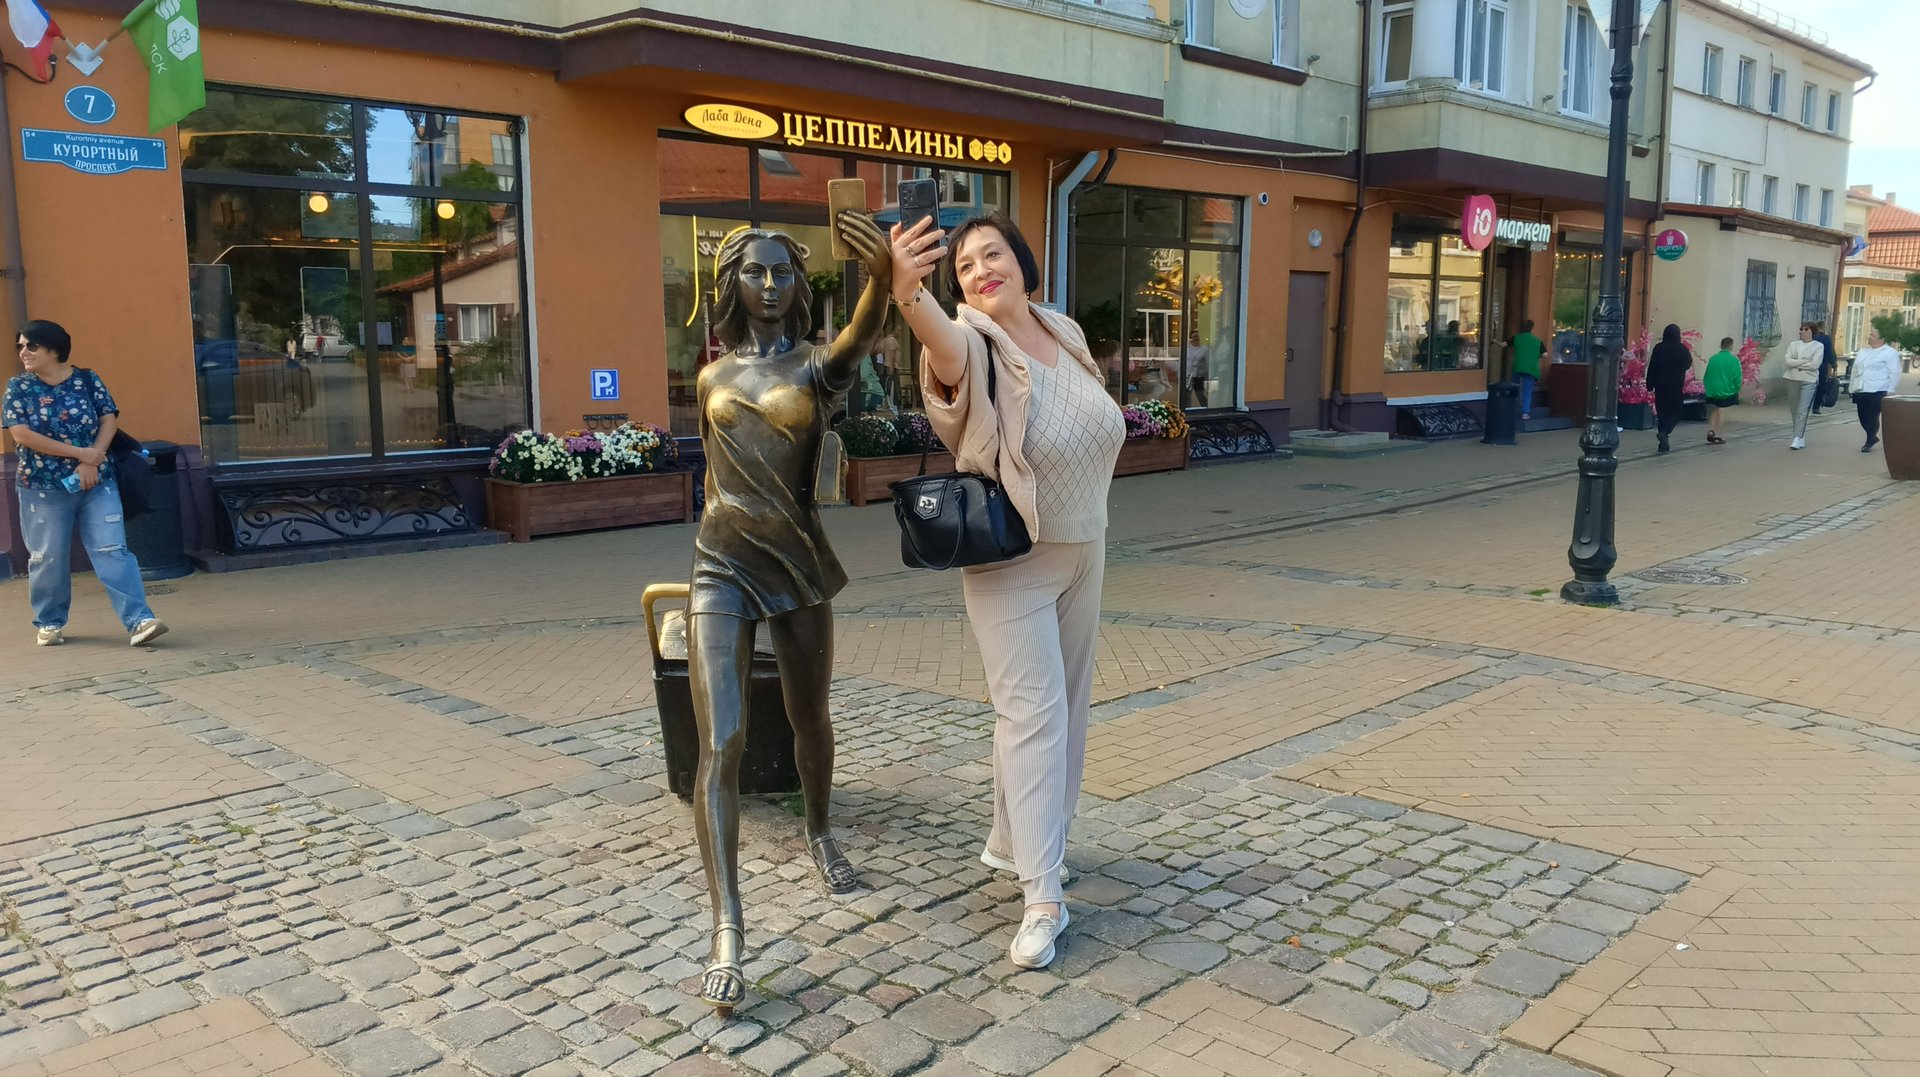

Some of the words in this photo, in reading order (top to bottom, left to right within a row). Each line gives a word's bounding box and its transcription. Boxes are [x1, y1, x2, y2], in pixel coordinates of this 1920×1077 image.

[84, 94, 95, 114] 7
[702, 109, 729, 123] Лаба
[733, 110, 762, 129] Дена
[65, 133, 98, 144] Kurortniy
[782, 112, 964, 160] ЦЕППЕЛИНЫ
[53, 143, 139, 162] КУРОРТНЫЙ
[74, 160, 118, 172] ПРОСПЕКТ
[1495, 218, 1551, 245] маркет
[594, 371, 612, 397] P
